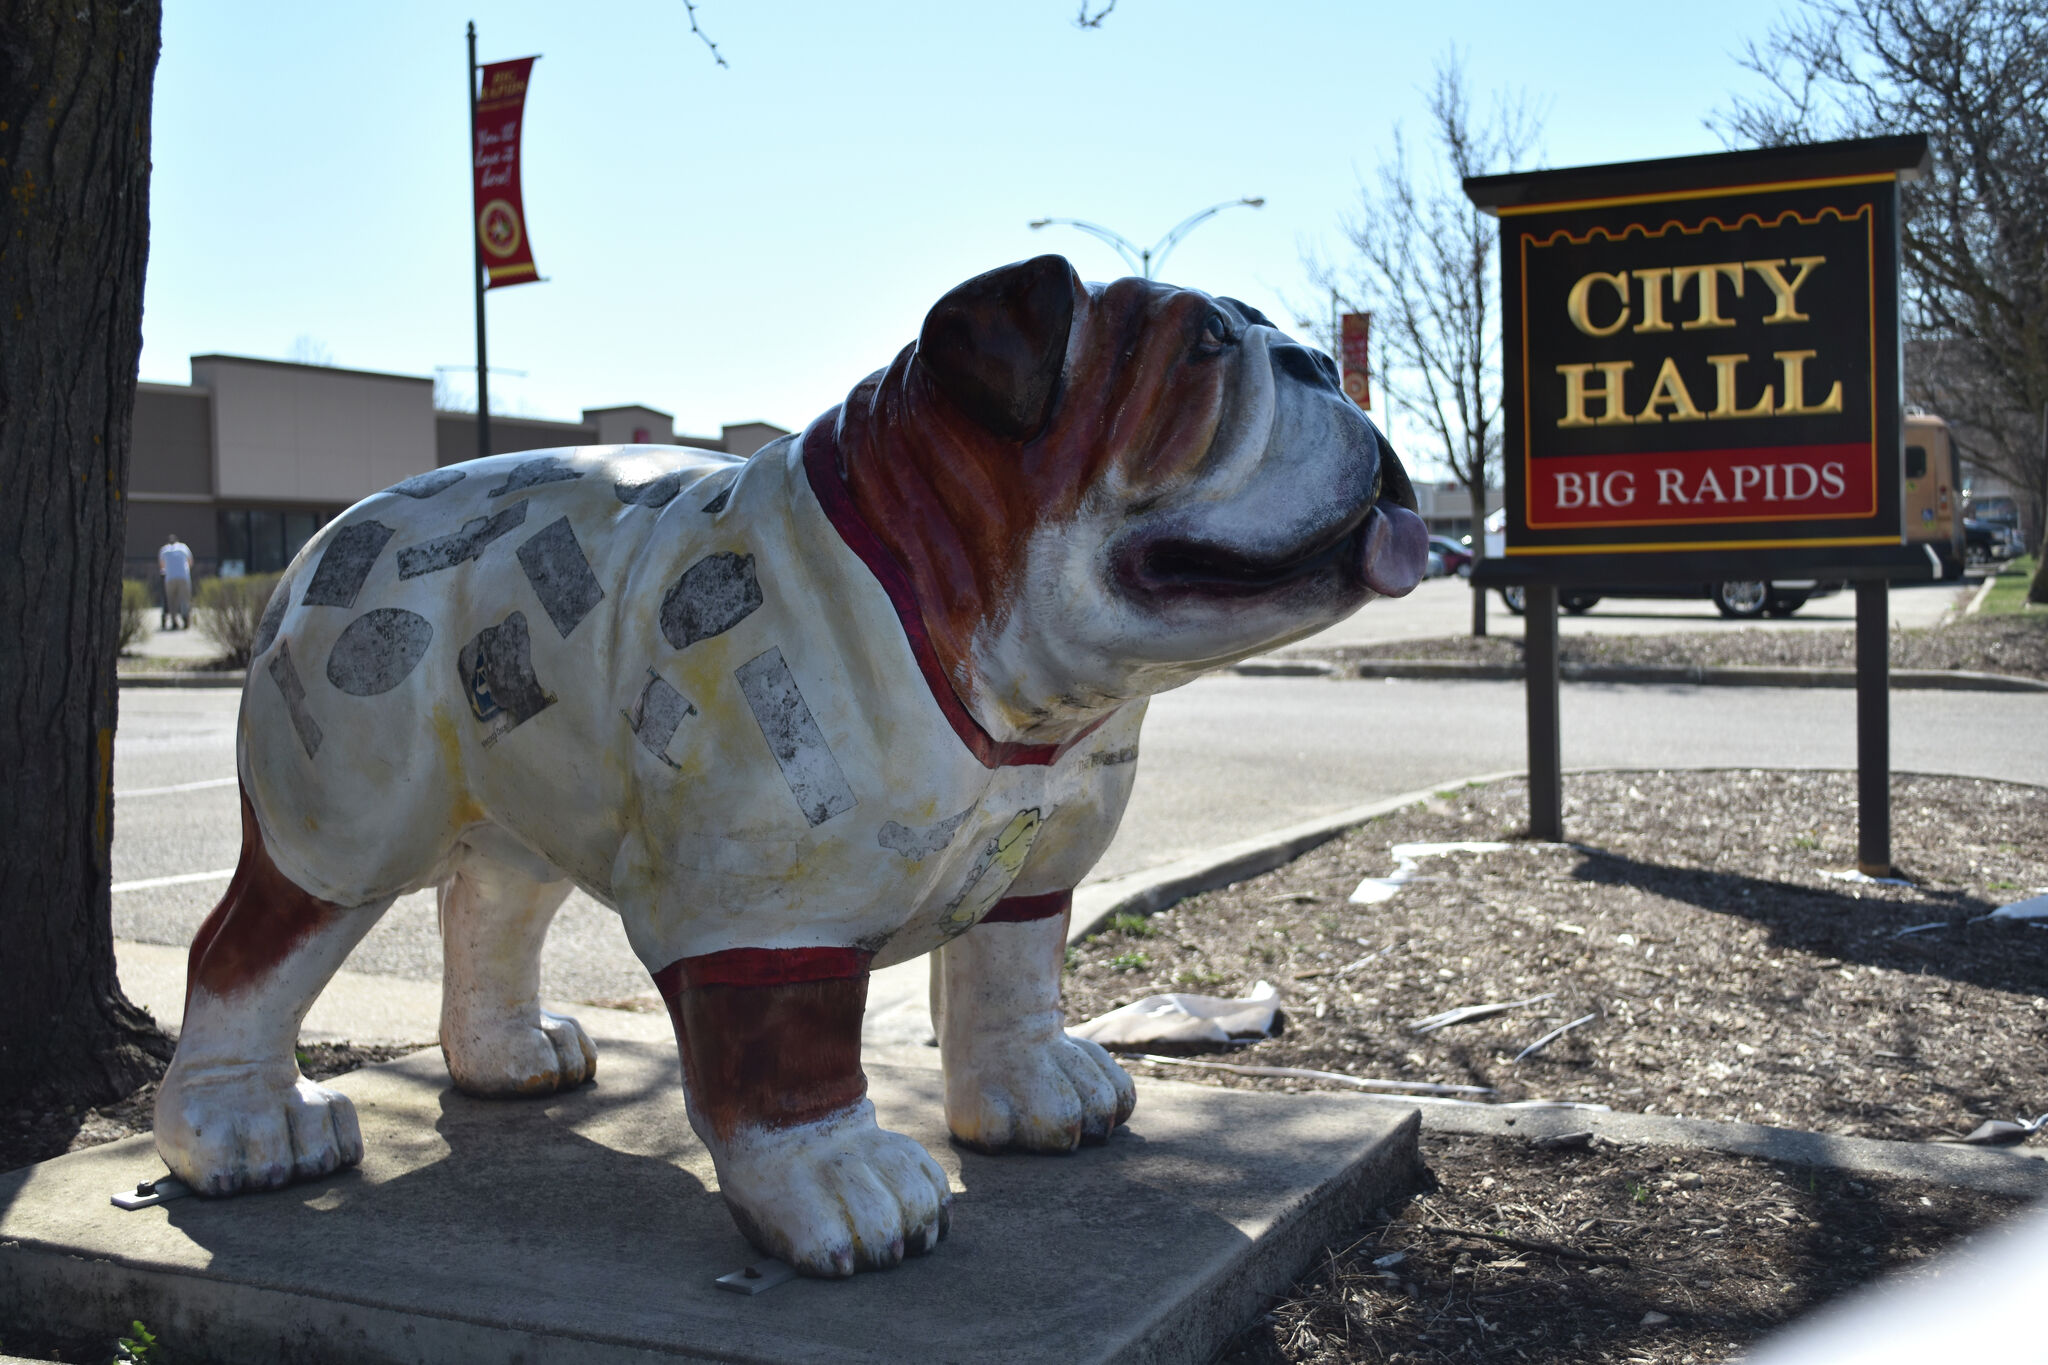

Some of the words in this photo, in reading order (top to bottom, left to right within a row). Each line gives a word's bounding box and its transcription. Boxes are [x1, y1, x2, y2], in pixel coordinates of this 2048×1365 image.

[1567, 256, 1826, 337] CITY
[1556, 350, 1843, 428] HALL
[1555, 471, 1637, 509] BIG
[1656, 462, 1846, 505] RAPIDS
